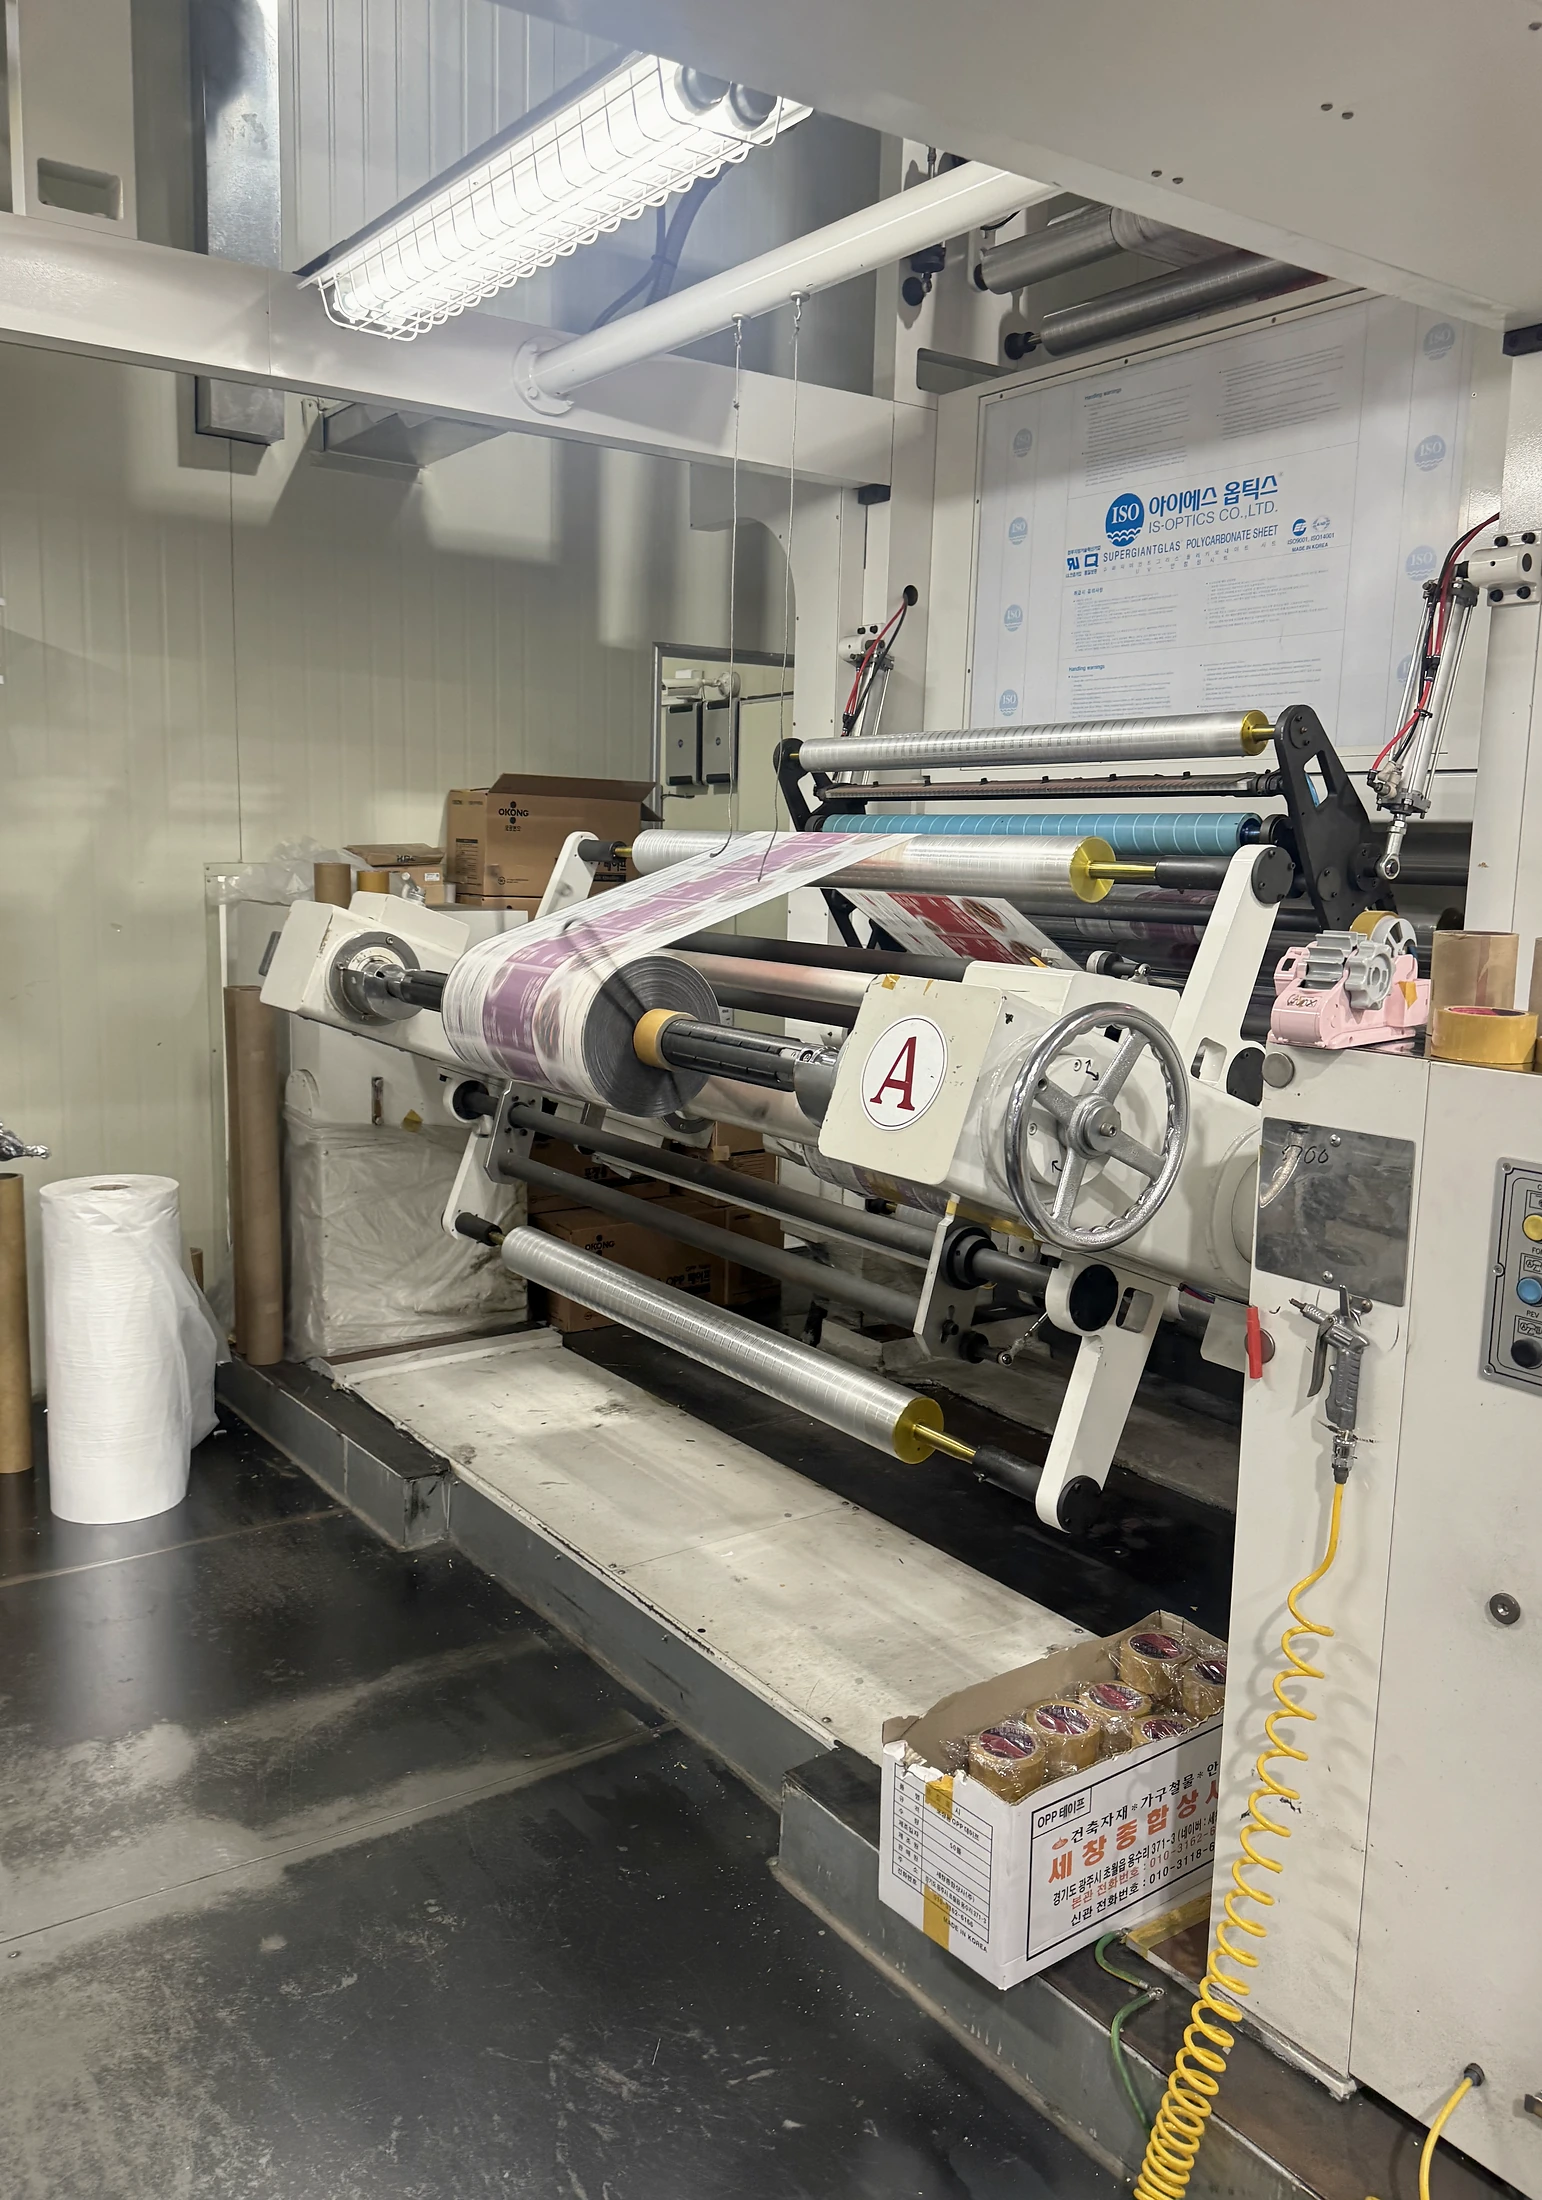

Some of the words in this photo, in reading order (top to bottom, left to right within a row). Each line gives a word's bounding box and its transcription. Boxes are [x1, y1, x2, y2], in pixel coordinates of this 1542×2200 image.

[1420, 441, 1442, 456] ISO
[1149, 487, 1218, 517] 아이에스
[1223, 475, 1278, 506] 옵틱스
[1111, 502, 1140, 524] ISO
[1149, 506, 1215, 534] IS-OPTICS
[1219, 500, 1278, 522] CO.,LTD.
[1103, 540, 1181, 563] SUPERGIANTGLAS
[1186, 529, 1251, 550] POLYCARBONATE
[1253, 525, 1278, 539] SHEET
[1411, 552, 1433, 566] ISO
[498, 808, 529, 817] OKONG
[869, 1035, 917, 1112] A
[585, 1239, 615, 1251] OKONG
[1526, 1309, 1540, 1319] REV
[1037, 1811, 1058, 1829] OPP
[1059, 1797, 1086, 1819] 테이프
[1071, 1805, 1128, 1844] 건축자재
[1141, 1773, 1195, 1810] 가구철물
[1053, 1883, 1077, 1907] 경기도
[1078, 1869, 1102, 1895] 광주시
[1103, 1859, 1126, 1881] 초월읍
[1128, 1845, 1150, 1869] 용수리
[1151, 1832, 1176, 1855] 371-3
[1071, 1905, 1093, 1927] 신관
[1097, 1882, 1140, 1912] 전화번호
[1149, 1841, 1215, 1884] 010-3118-6
[1071, 1889, 1093, 1910] 본관
[1097, 1866, 1140, 1895] 전화번호
[967, 1933, 988, 1953] KOREA
